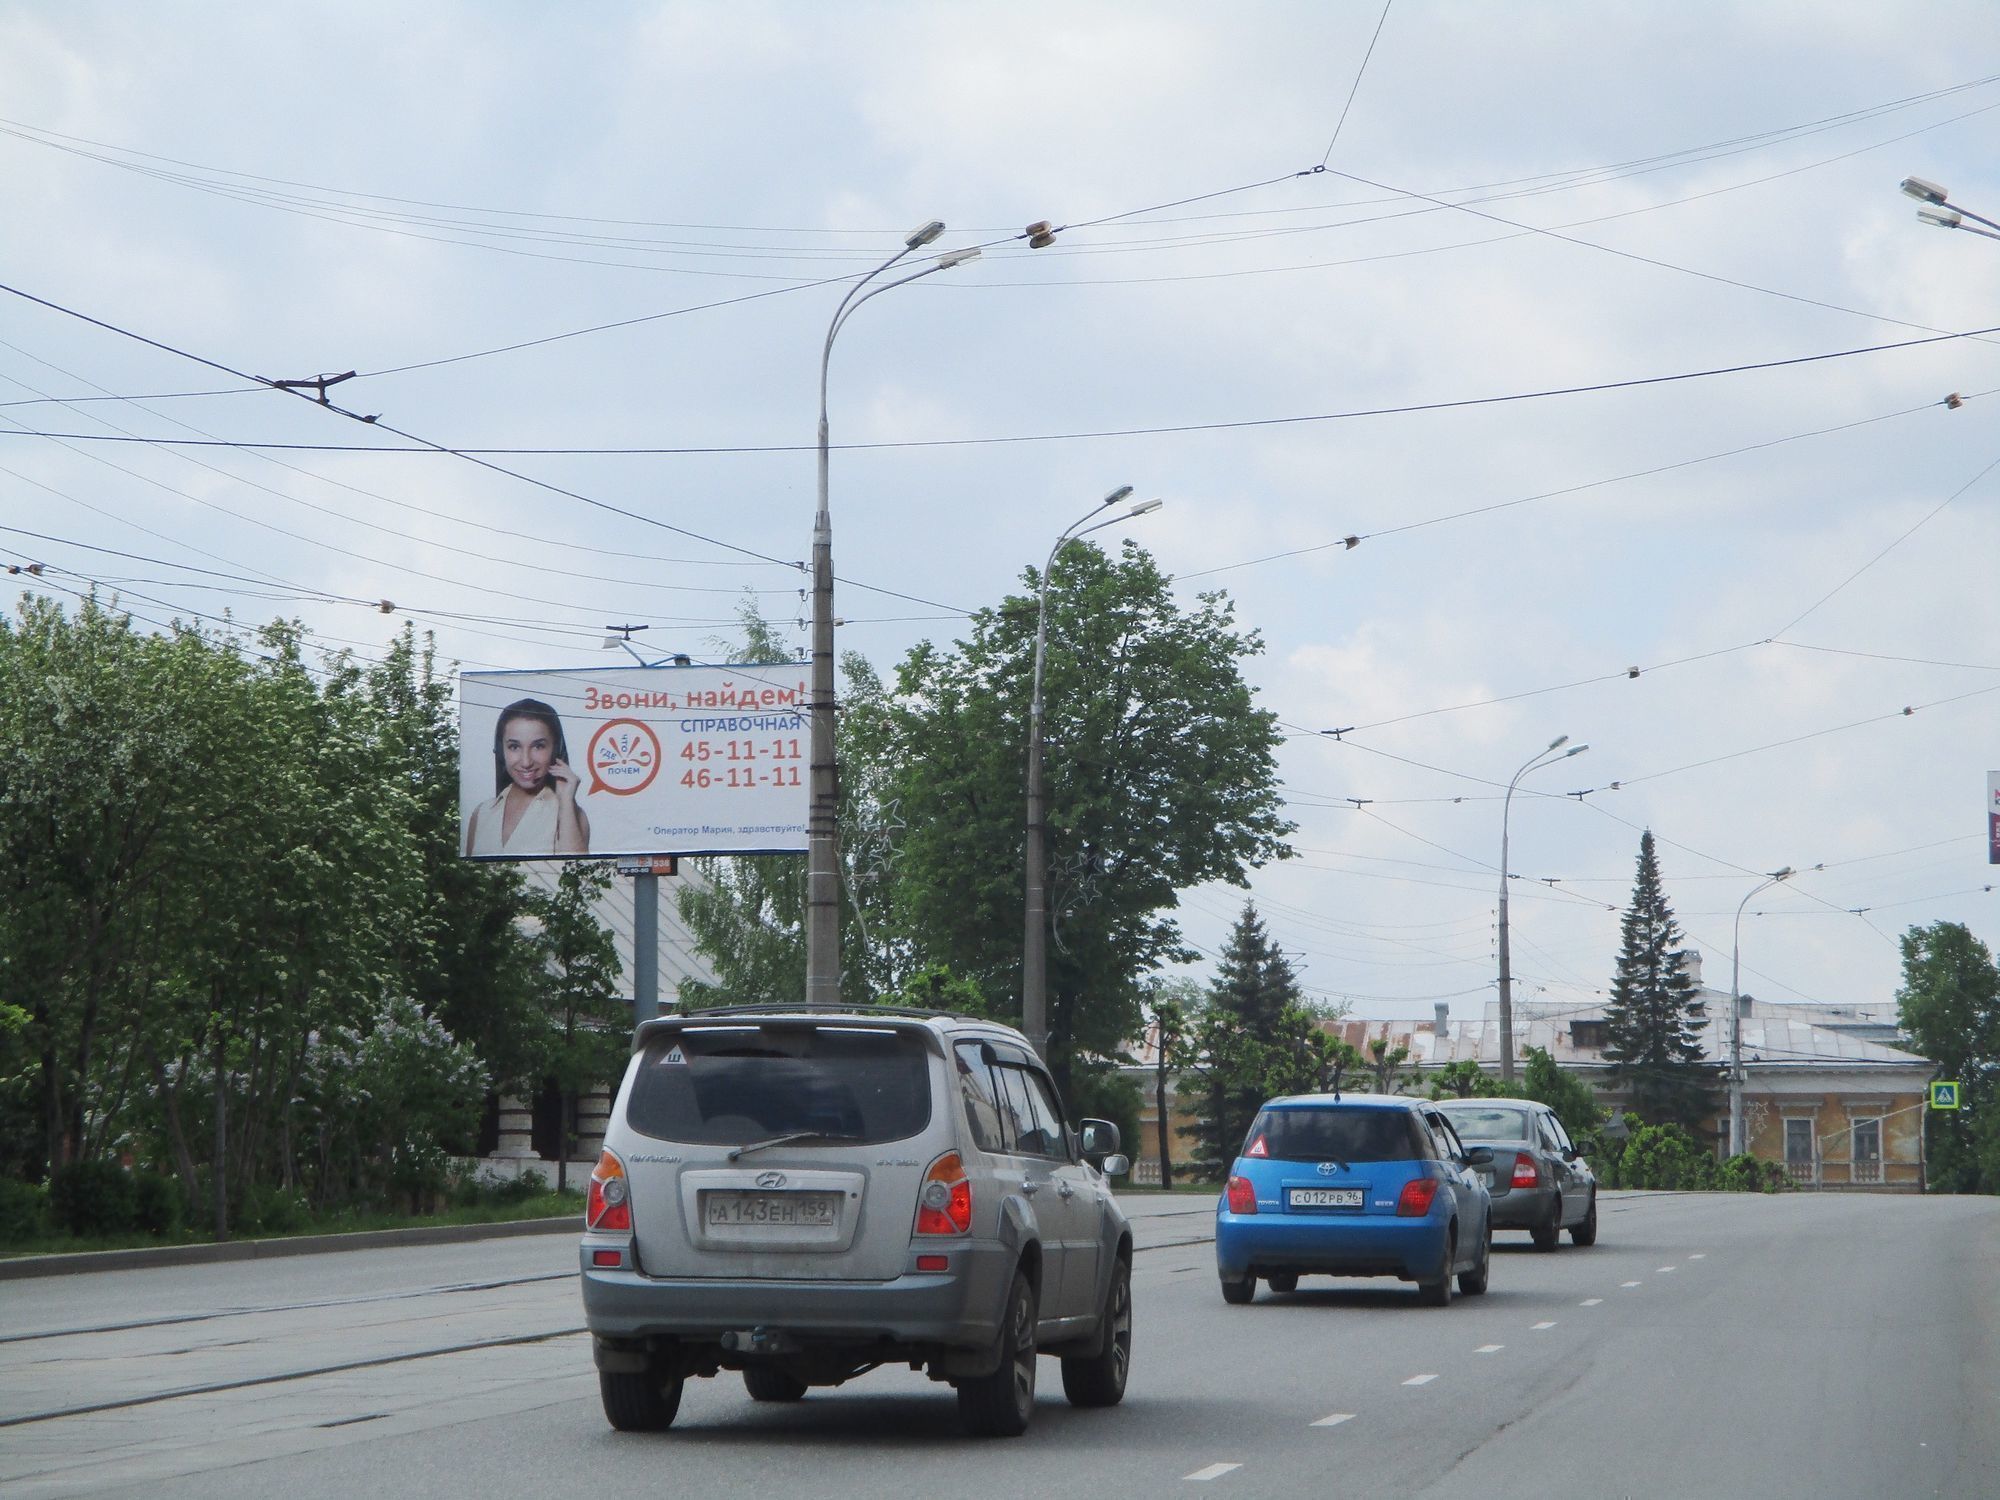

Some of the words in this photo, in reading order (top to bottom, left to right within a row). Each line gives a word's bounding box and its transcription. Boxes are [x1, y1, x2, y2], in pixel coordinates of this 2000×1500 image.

[585, 686, 677, 711] Звони,
[687, 682, 805, 711] найдем!
[680, 716, 801, 733] СПРАВОЧНАЯ
[680, 739, 802, 761] 45-11-11
[608, 767, 640, 775] ПОЧЕМ
[680, 766, 802, 789] 46-11-11
[654, 826, 699, 836] Оператор
